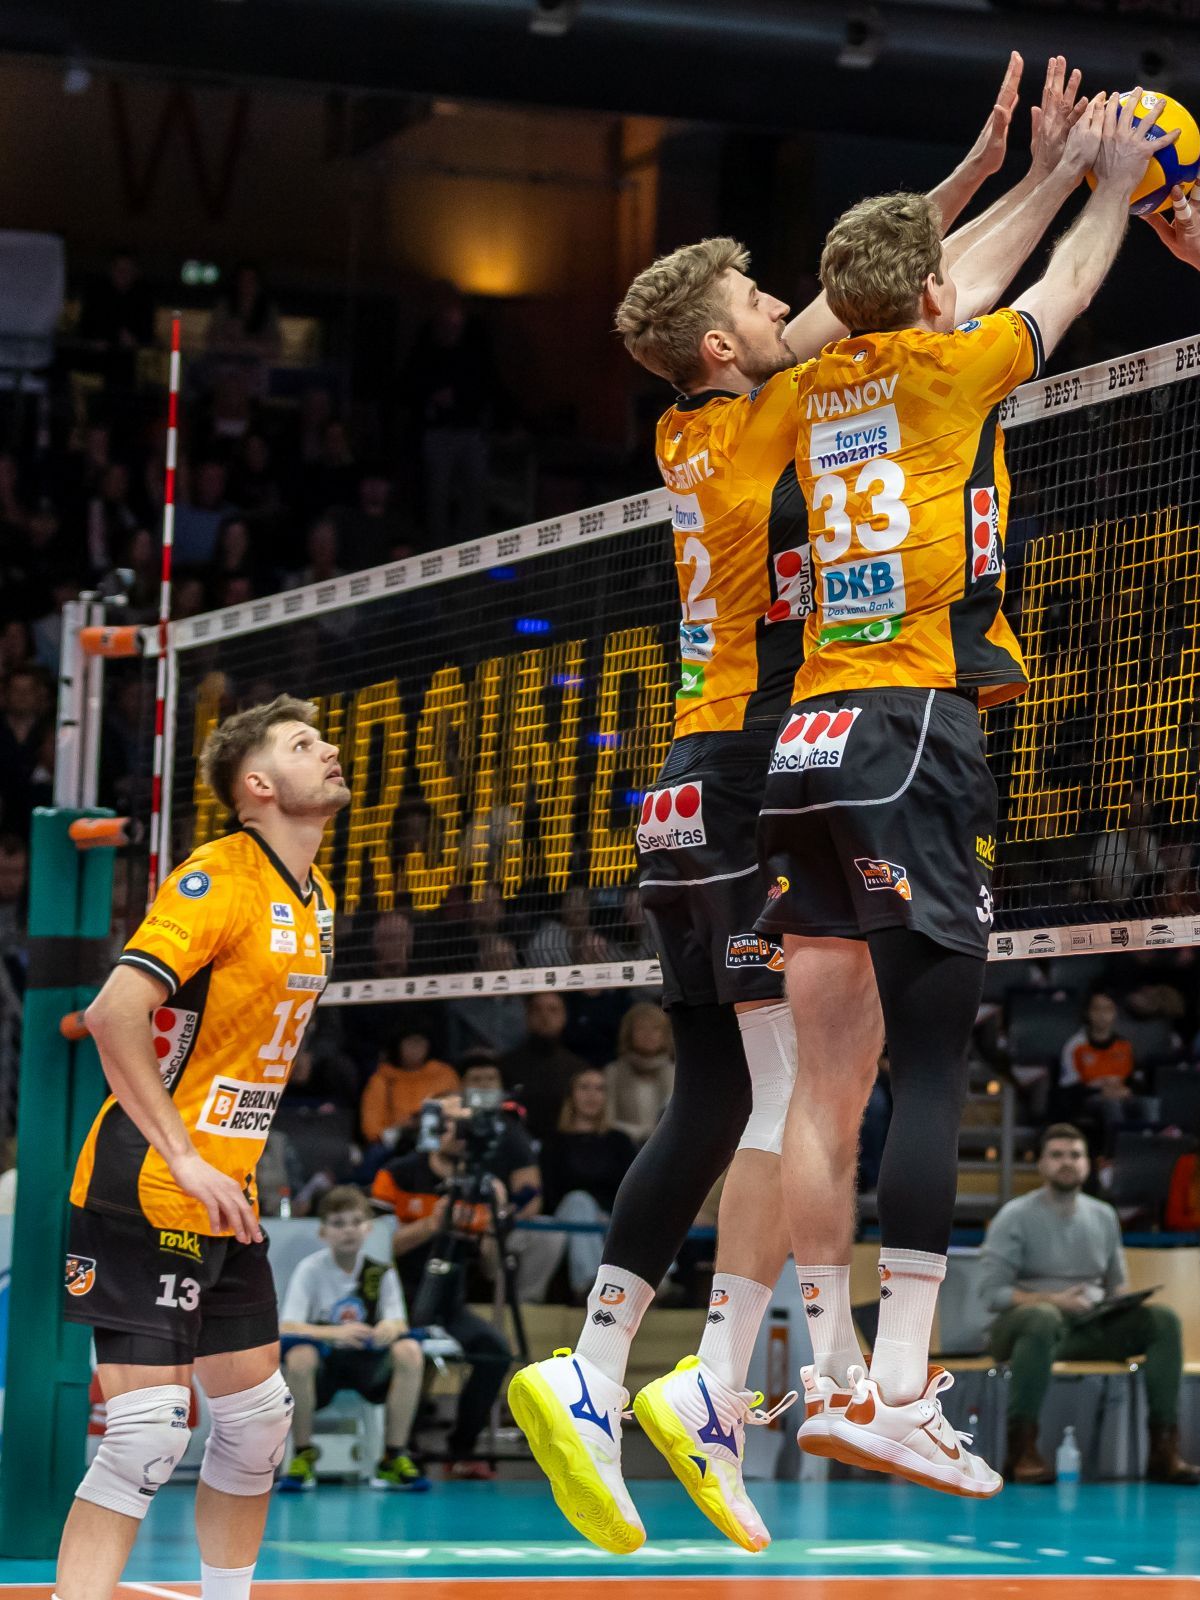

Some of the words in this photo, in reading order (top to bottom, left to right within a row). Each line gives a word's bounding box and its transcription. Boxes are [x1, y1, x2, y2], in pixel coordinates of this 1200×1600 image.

[806, 373, 899, 420] IVANOV
[818, 440, 888, 469] mazars
[811, 458, 910, 563] 33
[682, 537, 719, 619] 2
[825, 561, 895, 604] DKB
[827, 607, 844, 618] Das
[869, 599, 895, 613] Bank
[771, 749, 840, 771] Secuitas
[733, 939, 758, 948] BERLIN
[162, 1014, 197, 1085] Securitas
[258, 999, 316, 1061] 13
[239, 1090, 279, 1110] BERLIN
[155, 1274, 201, 1312] 13
